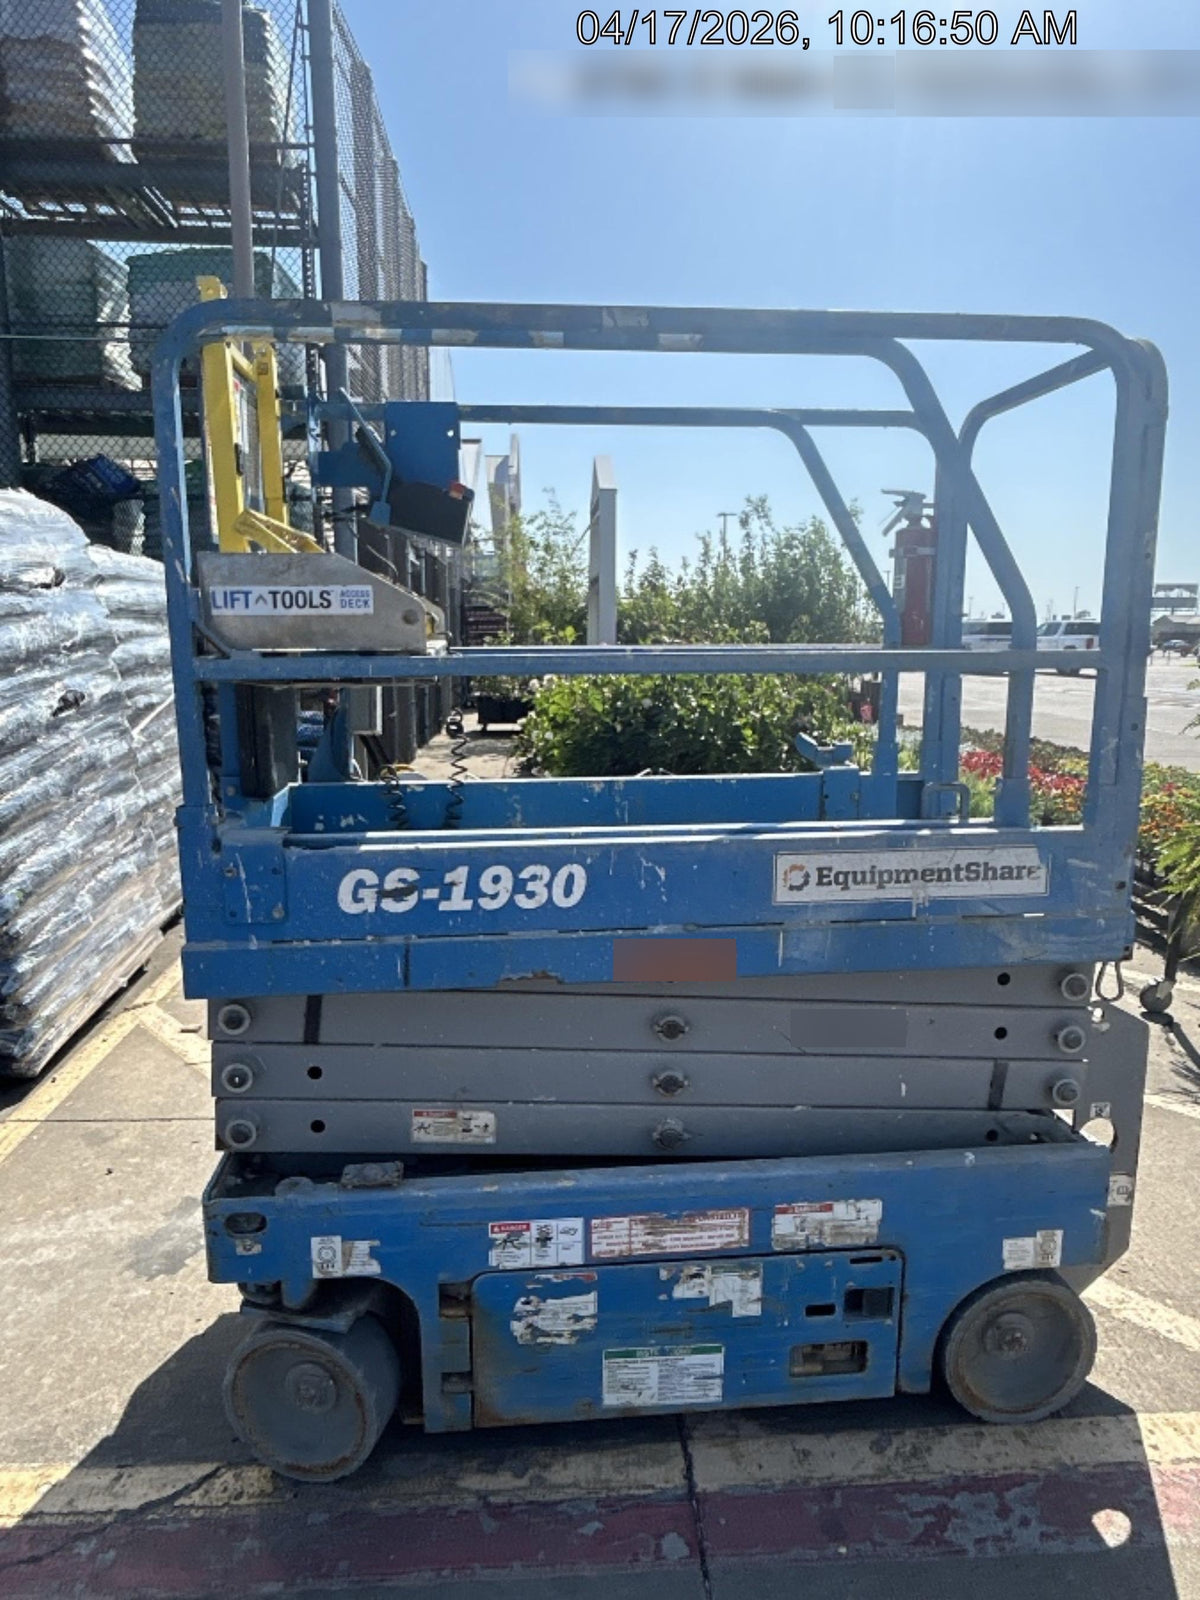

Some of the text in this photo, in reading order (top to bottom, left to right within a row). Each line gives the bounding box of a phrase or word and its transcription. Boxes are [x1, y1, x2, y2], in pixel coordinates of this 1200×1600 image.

[210, 590, 332, 609] LIFT TOOLS
[340, 589, 370, 598] ACCESS
[340, 599, 370, 609] DECK
[815, 861, 1042, 891] EquipmentShare
[337, 863, 588, 915] GS-1930
